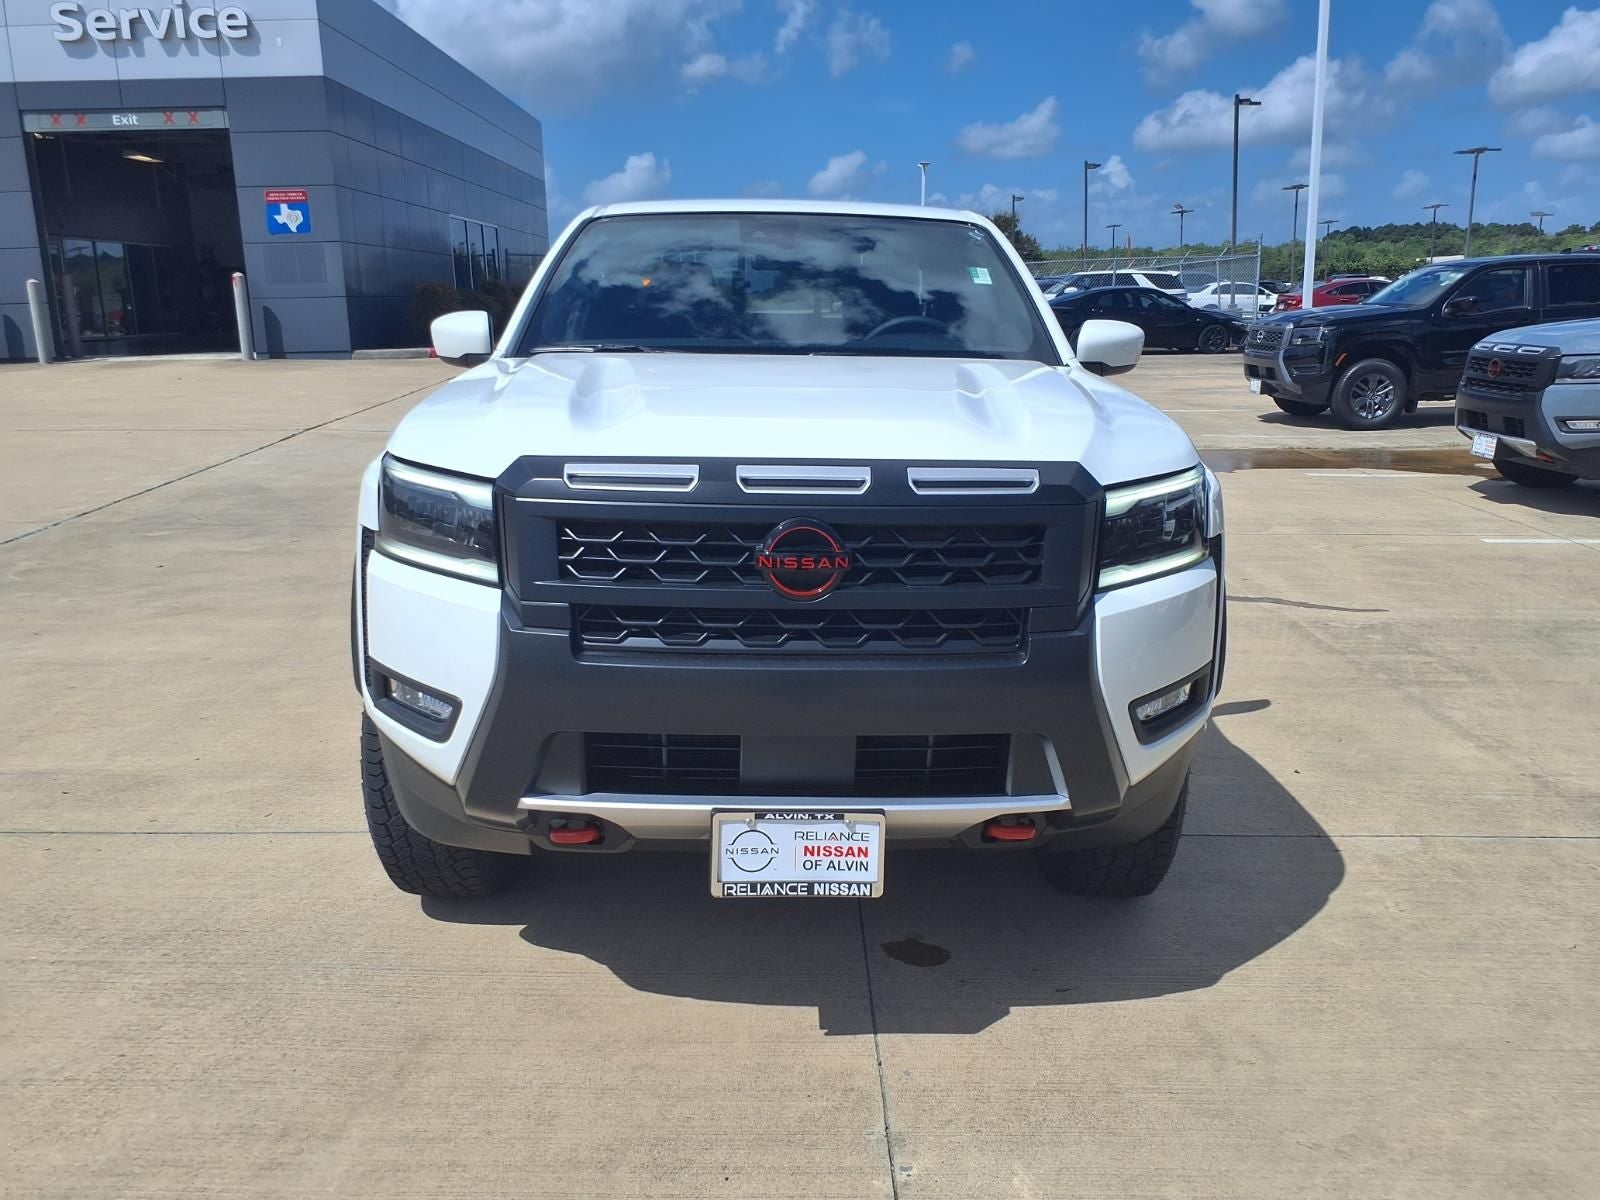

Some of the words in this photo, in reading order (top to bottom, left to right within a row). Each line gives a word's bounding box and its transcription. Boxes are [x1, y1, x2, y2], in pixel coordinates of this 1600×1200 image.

[50, 0, 248, 42] Service
[112, 113, 139, 126] Exit
[758, 555, 849, 569] NISSAN
[794, 831, 870, 842] RELIANCE
[725, 847, 780, 855] NISSAN
[803, 845, 869, 858] NISSAN
[802, 859, 822, 871] OF
[826, 859, 869, 872] ALVIN
[724, 883, 808, 896] RELIANCE
[813, 883, 871, 896] NISSAN
